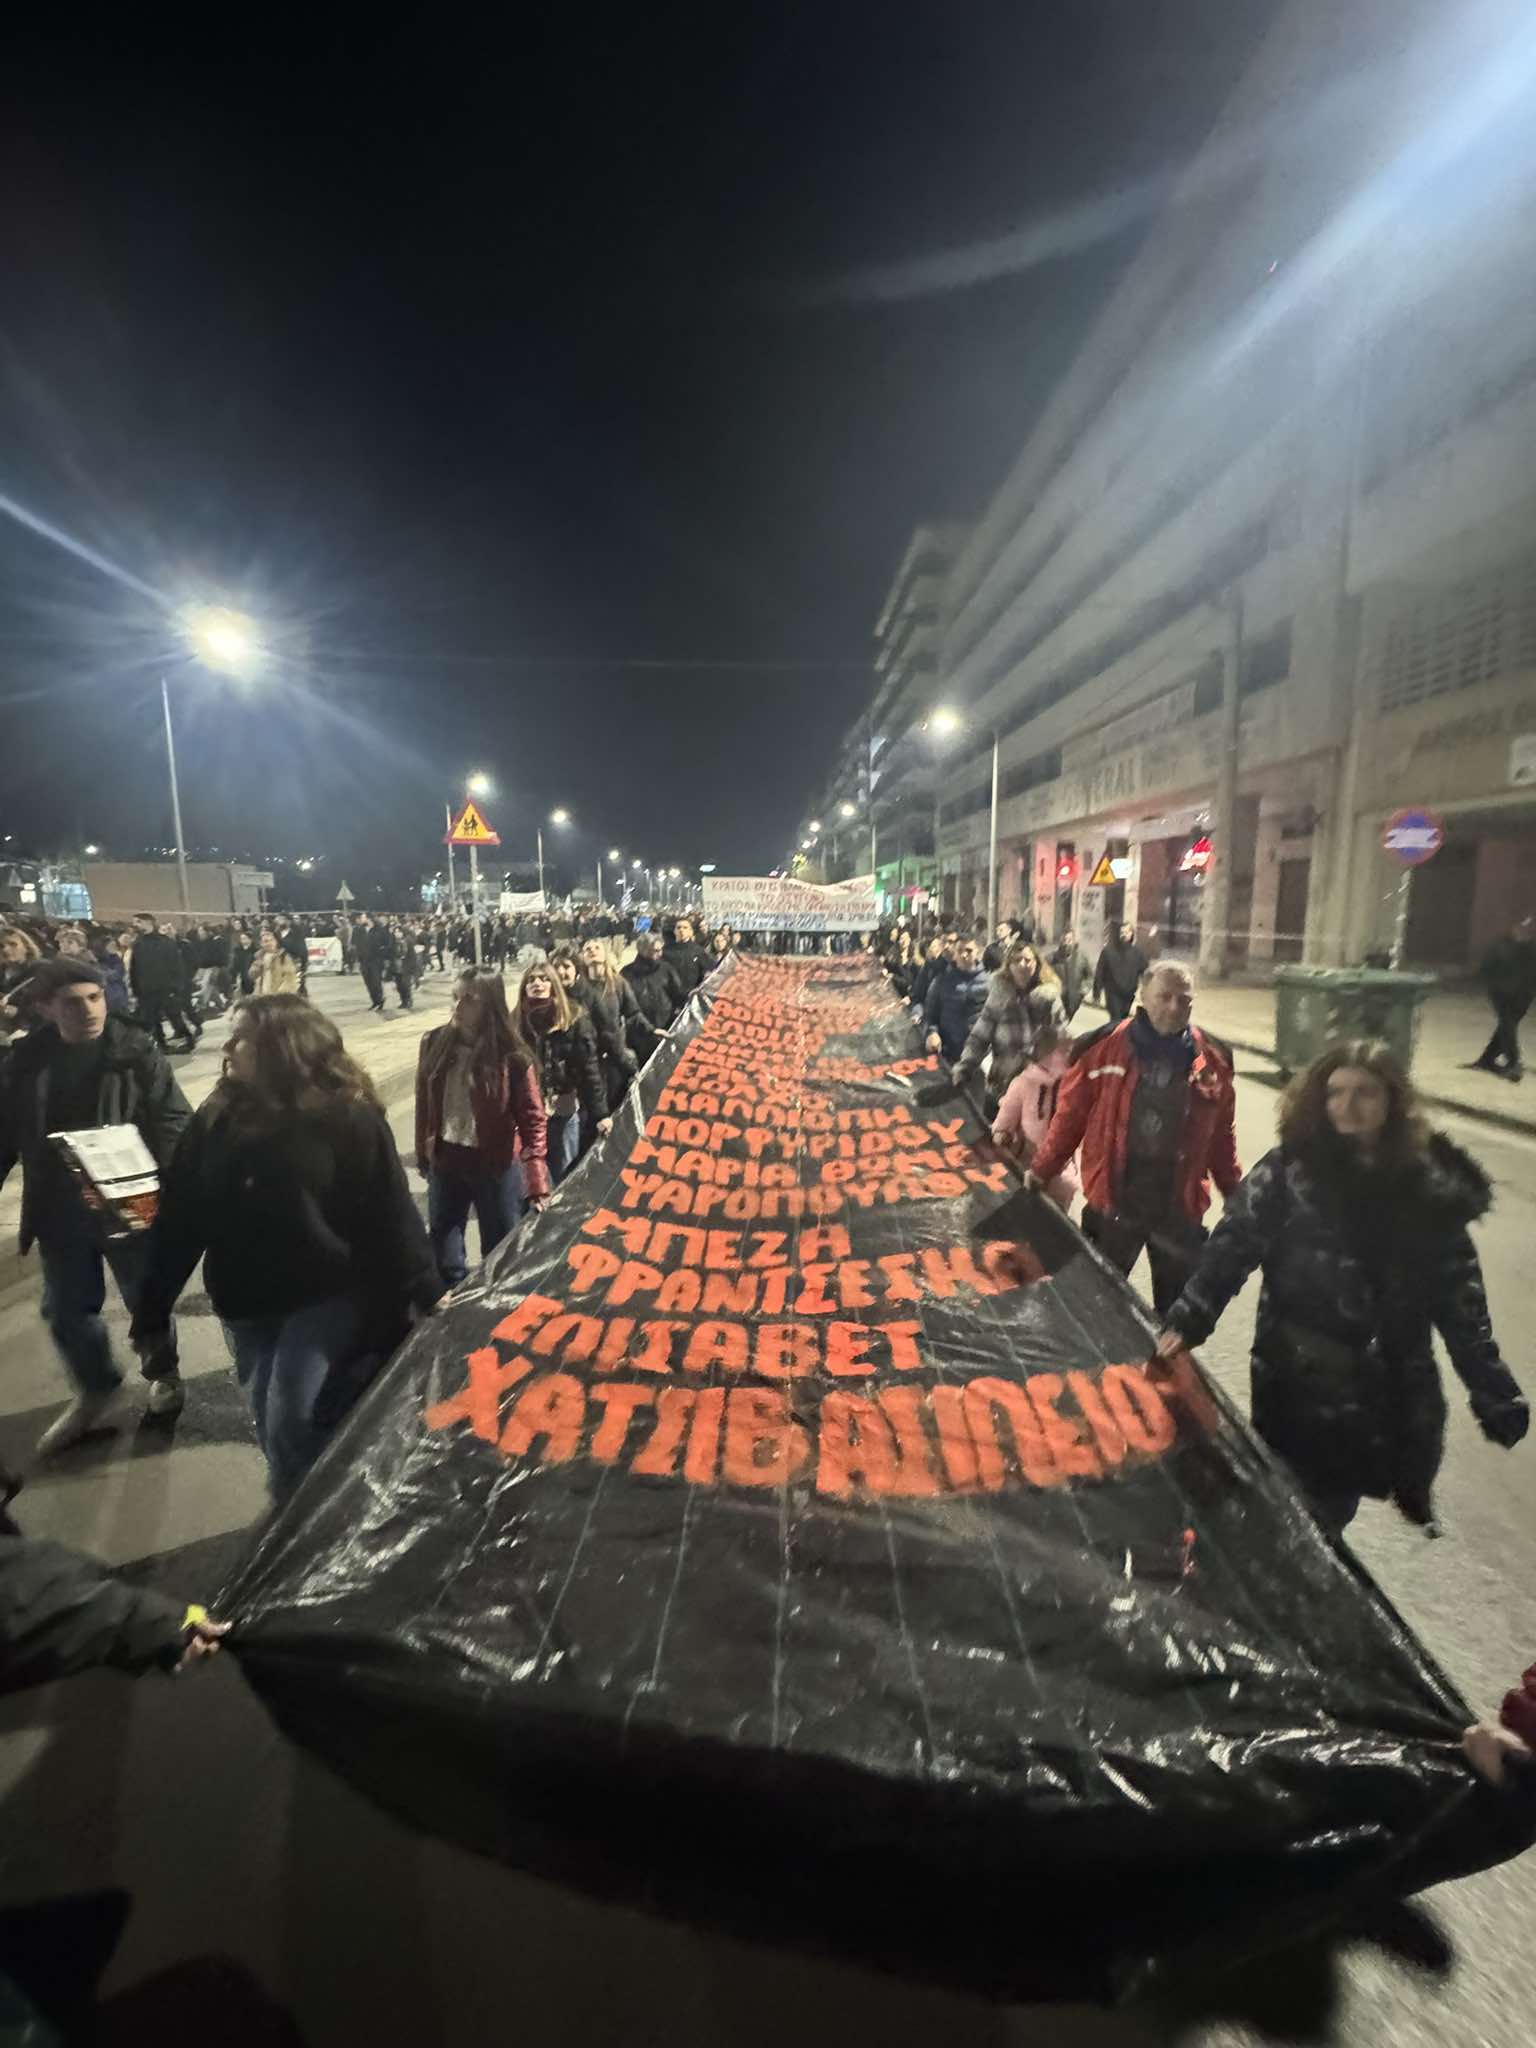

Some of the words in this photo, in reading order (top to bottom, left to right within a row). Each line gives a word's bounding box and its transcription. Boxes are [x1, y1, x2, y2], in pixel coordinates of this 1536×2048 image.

[656, 1087, 912, 1134] ΚΑΛΛΙΟΠΗ
[629, 1138, 798, 1187] ΜΑΡΙΑ
[620, 1162, 1009, 1220] ΨΑΡΟΠΟΥΛΟΥ
[491, 1293, 924, 1377] ΕΛΙΣΑΒΕΤ
